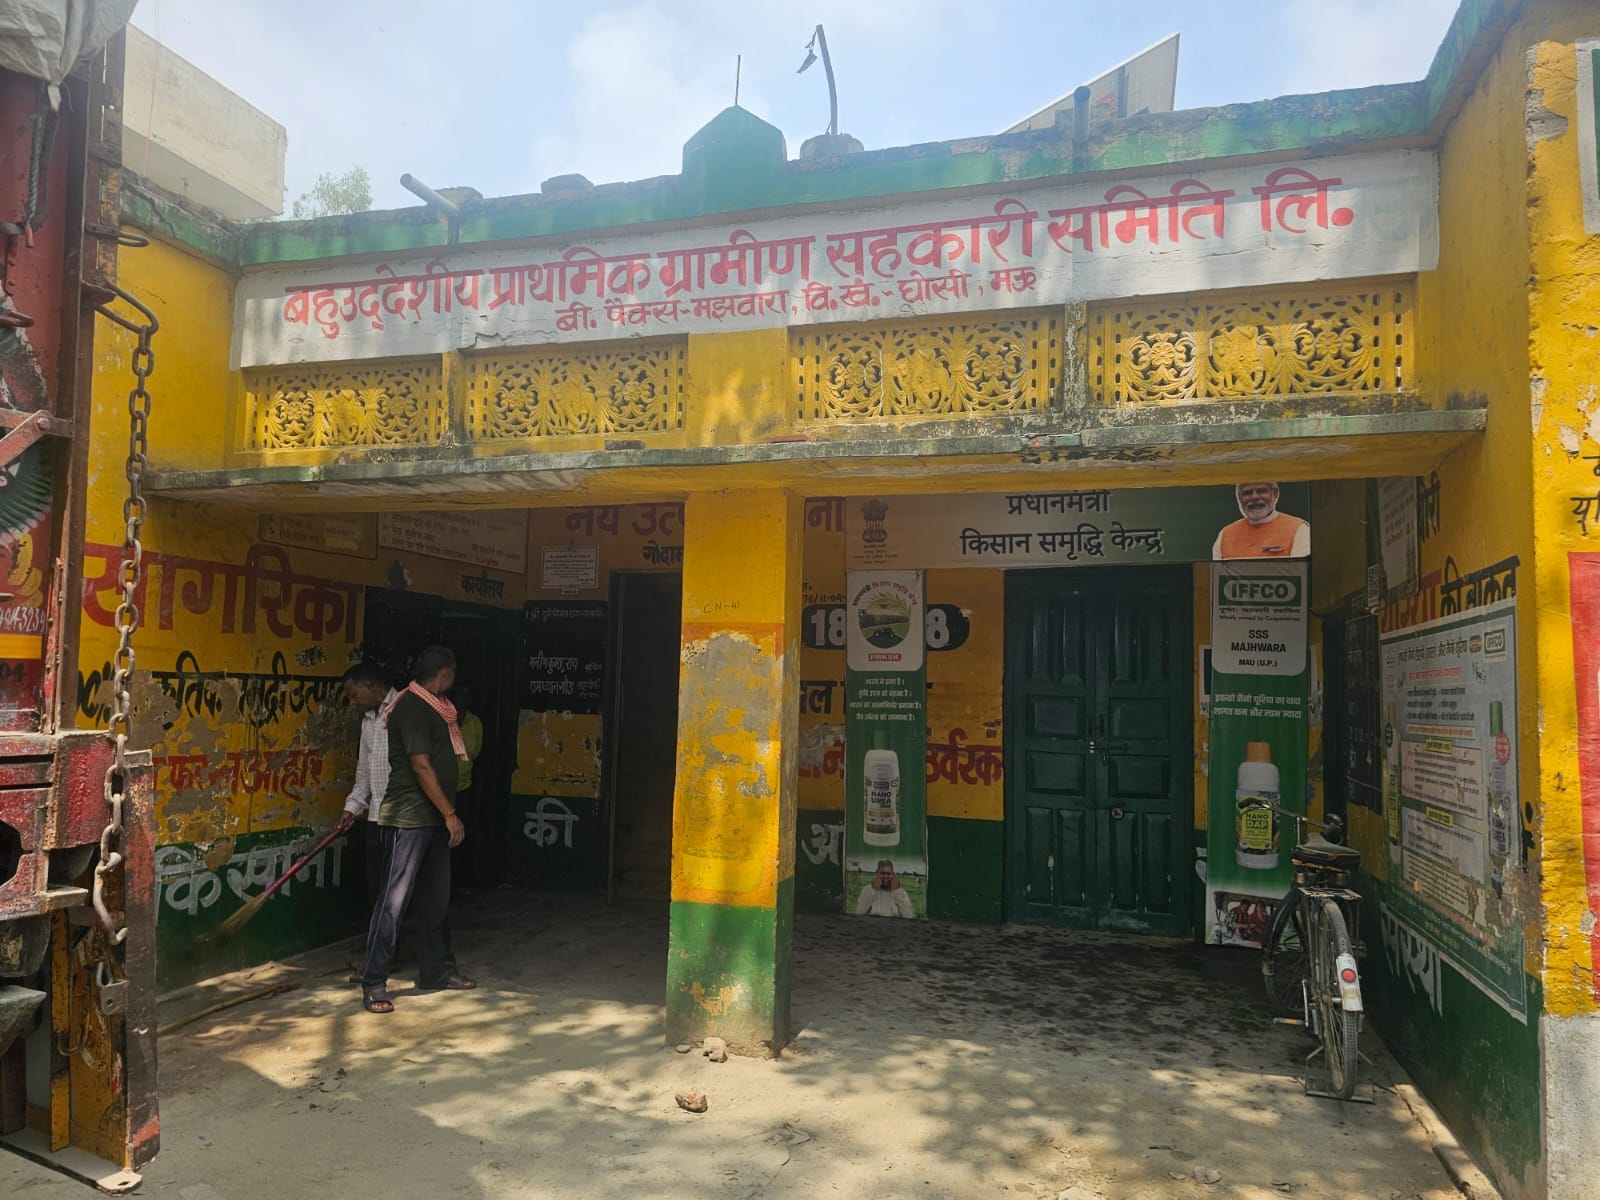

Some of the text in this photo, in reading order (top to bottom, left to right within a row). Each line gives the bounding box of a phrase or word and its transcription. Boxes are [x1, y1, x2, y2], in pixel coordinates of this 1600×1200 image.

[489, 246, 650, 309] प्राथमिक
[657, 228, 816, 297] ग्रामीण
[827, 198, 1038, 278] सहकारी
[1048, 178, 1234, 253] समिति
[1252, 166, 1355, 234] लि.
[989, 267, 1037, 293] मऊ
[960, 521, 1164, 560] किसान समृद्धि केन्द्र
[1231, 583, 1288, 598] IFFCO
[1248, 629, 1269, 639] SSS
[1231, 642, 1286, 653] MAJHWARA
[1238, 658, 1278, 667] MAU (U.P.)
[523, 797, 580, 848] की
[1247, 820, 1267, 829] DAP
